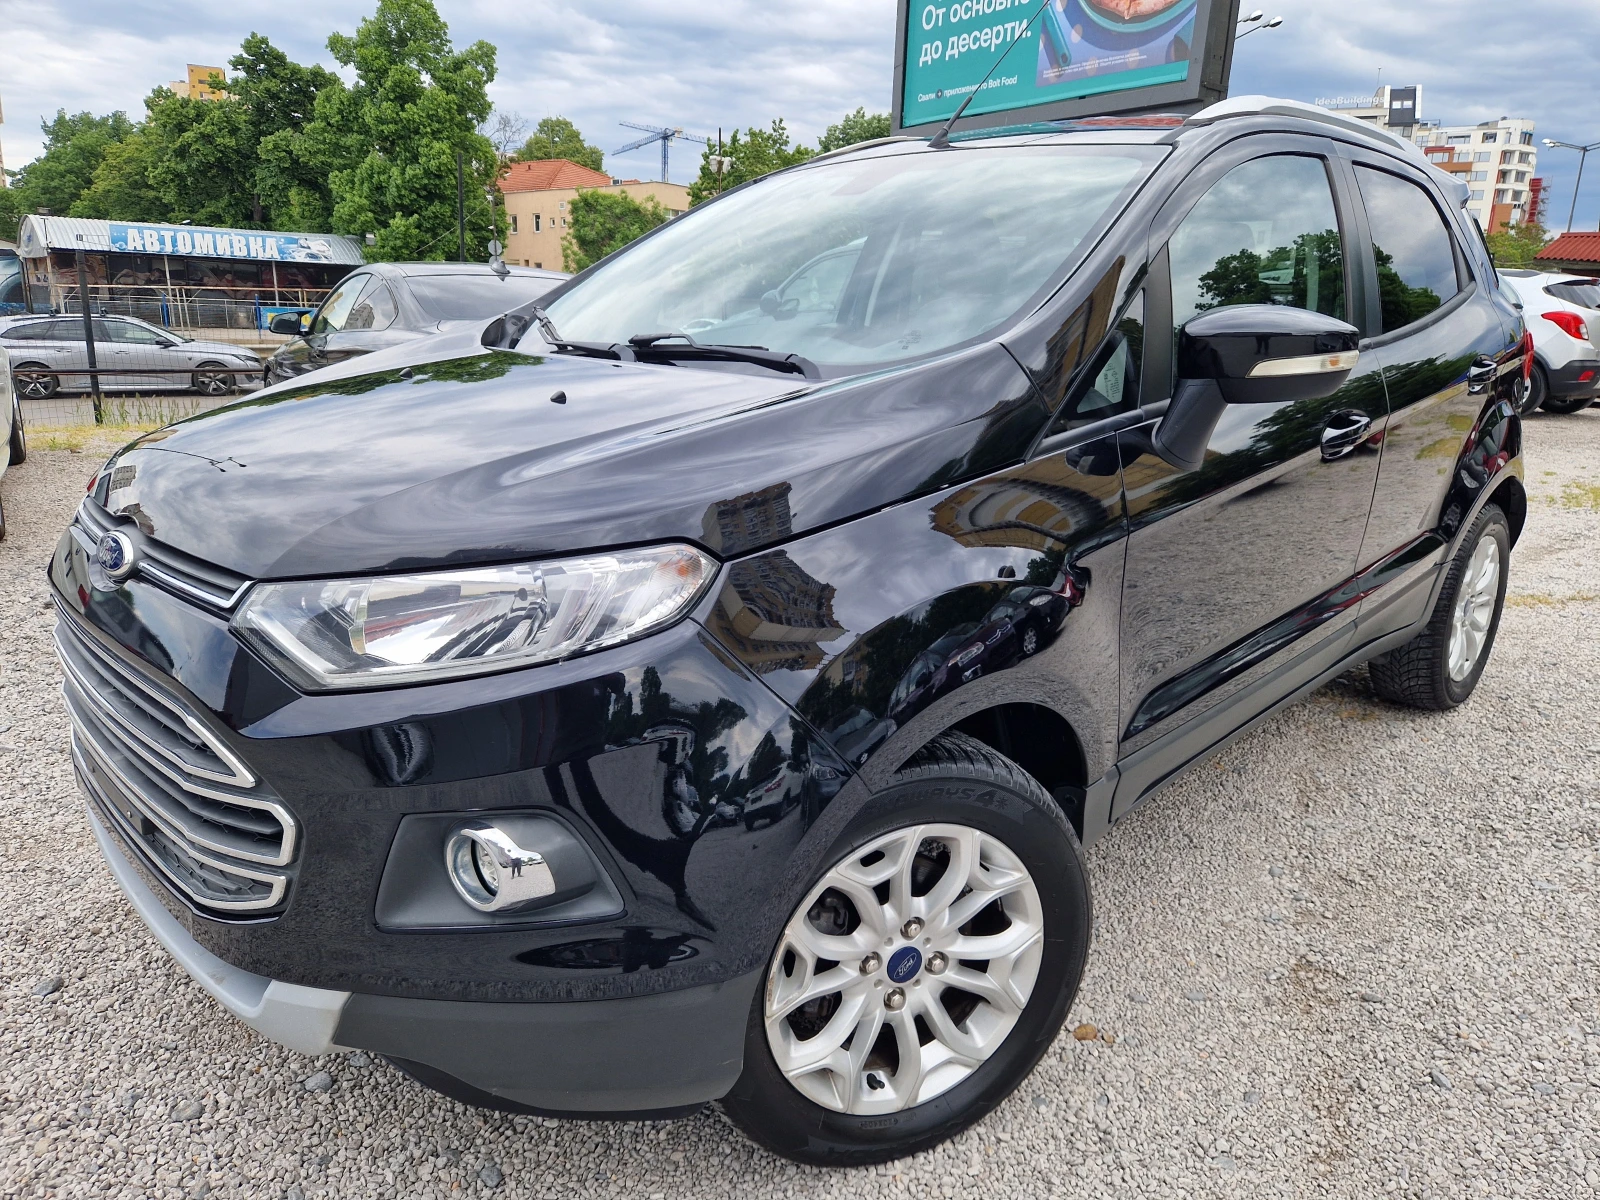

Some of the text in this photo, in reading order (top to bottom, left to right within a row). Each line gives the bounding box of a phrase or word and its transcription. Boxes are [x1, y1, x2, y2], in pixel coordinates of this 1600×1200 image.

[922, 0, 1030, 30] От основ
[919, 18, 1032, 67] до десерти.
[1001, 75, 1018, 87] Food
[1315, 96, 1385, 105] IdeaBuildings
[127, 228, 280, 259] АВТОМИВКА
